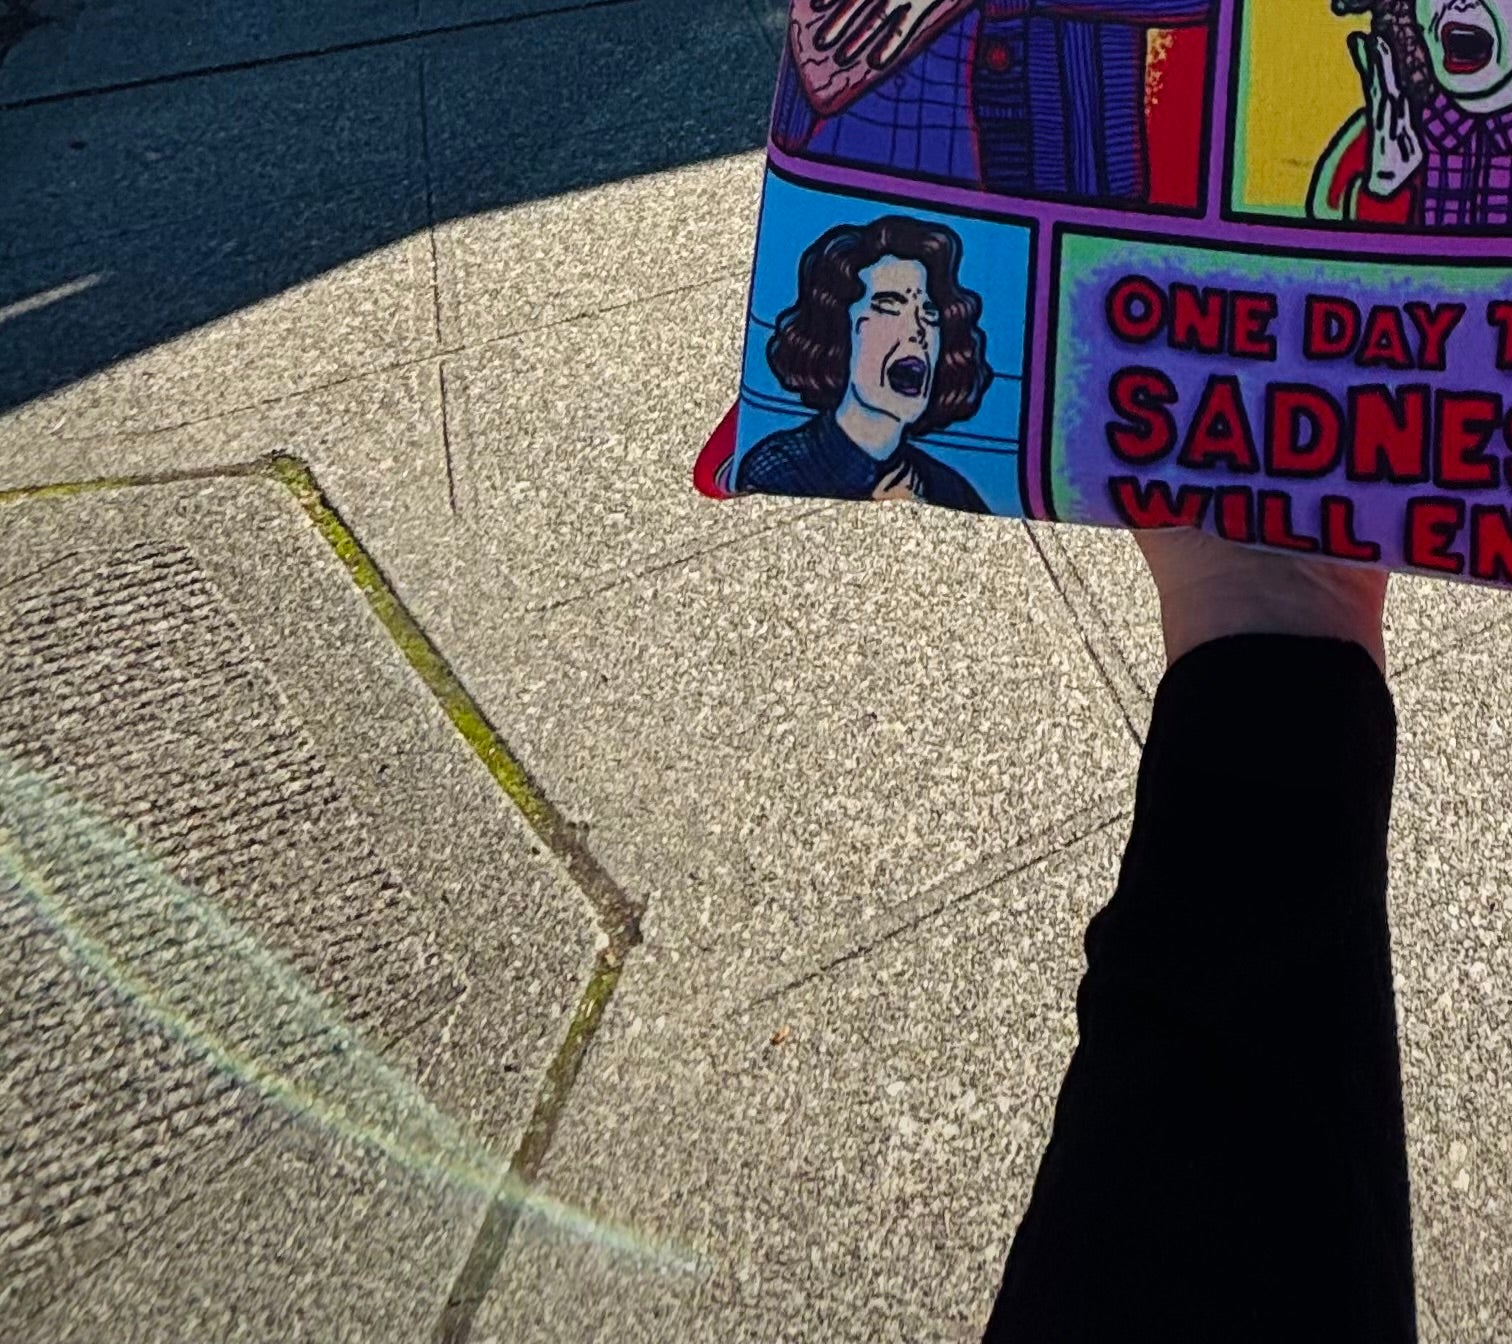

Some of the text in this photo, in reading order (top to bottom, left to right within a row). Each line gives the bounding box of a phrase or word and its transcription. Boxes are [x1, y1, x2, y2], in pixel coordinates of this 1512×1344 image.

[1105, 274, 1278, 362] ONE
[1302, 293, 1466, 372] DAY
[1108, 475, 1381, 561] WILL
